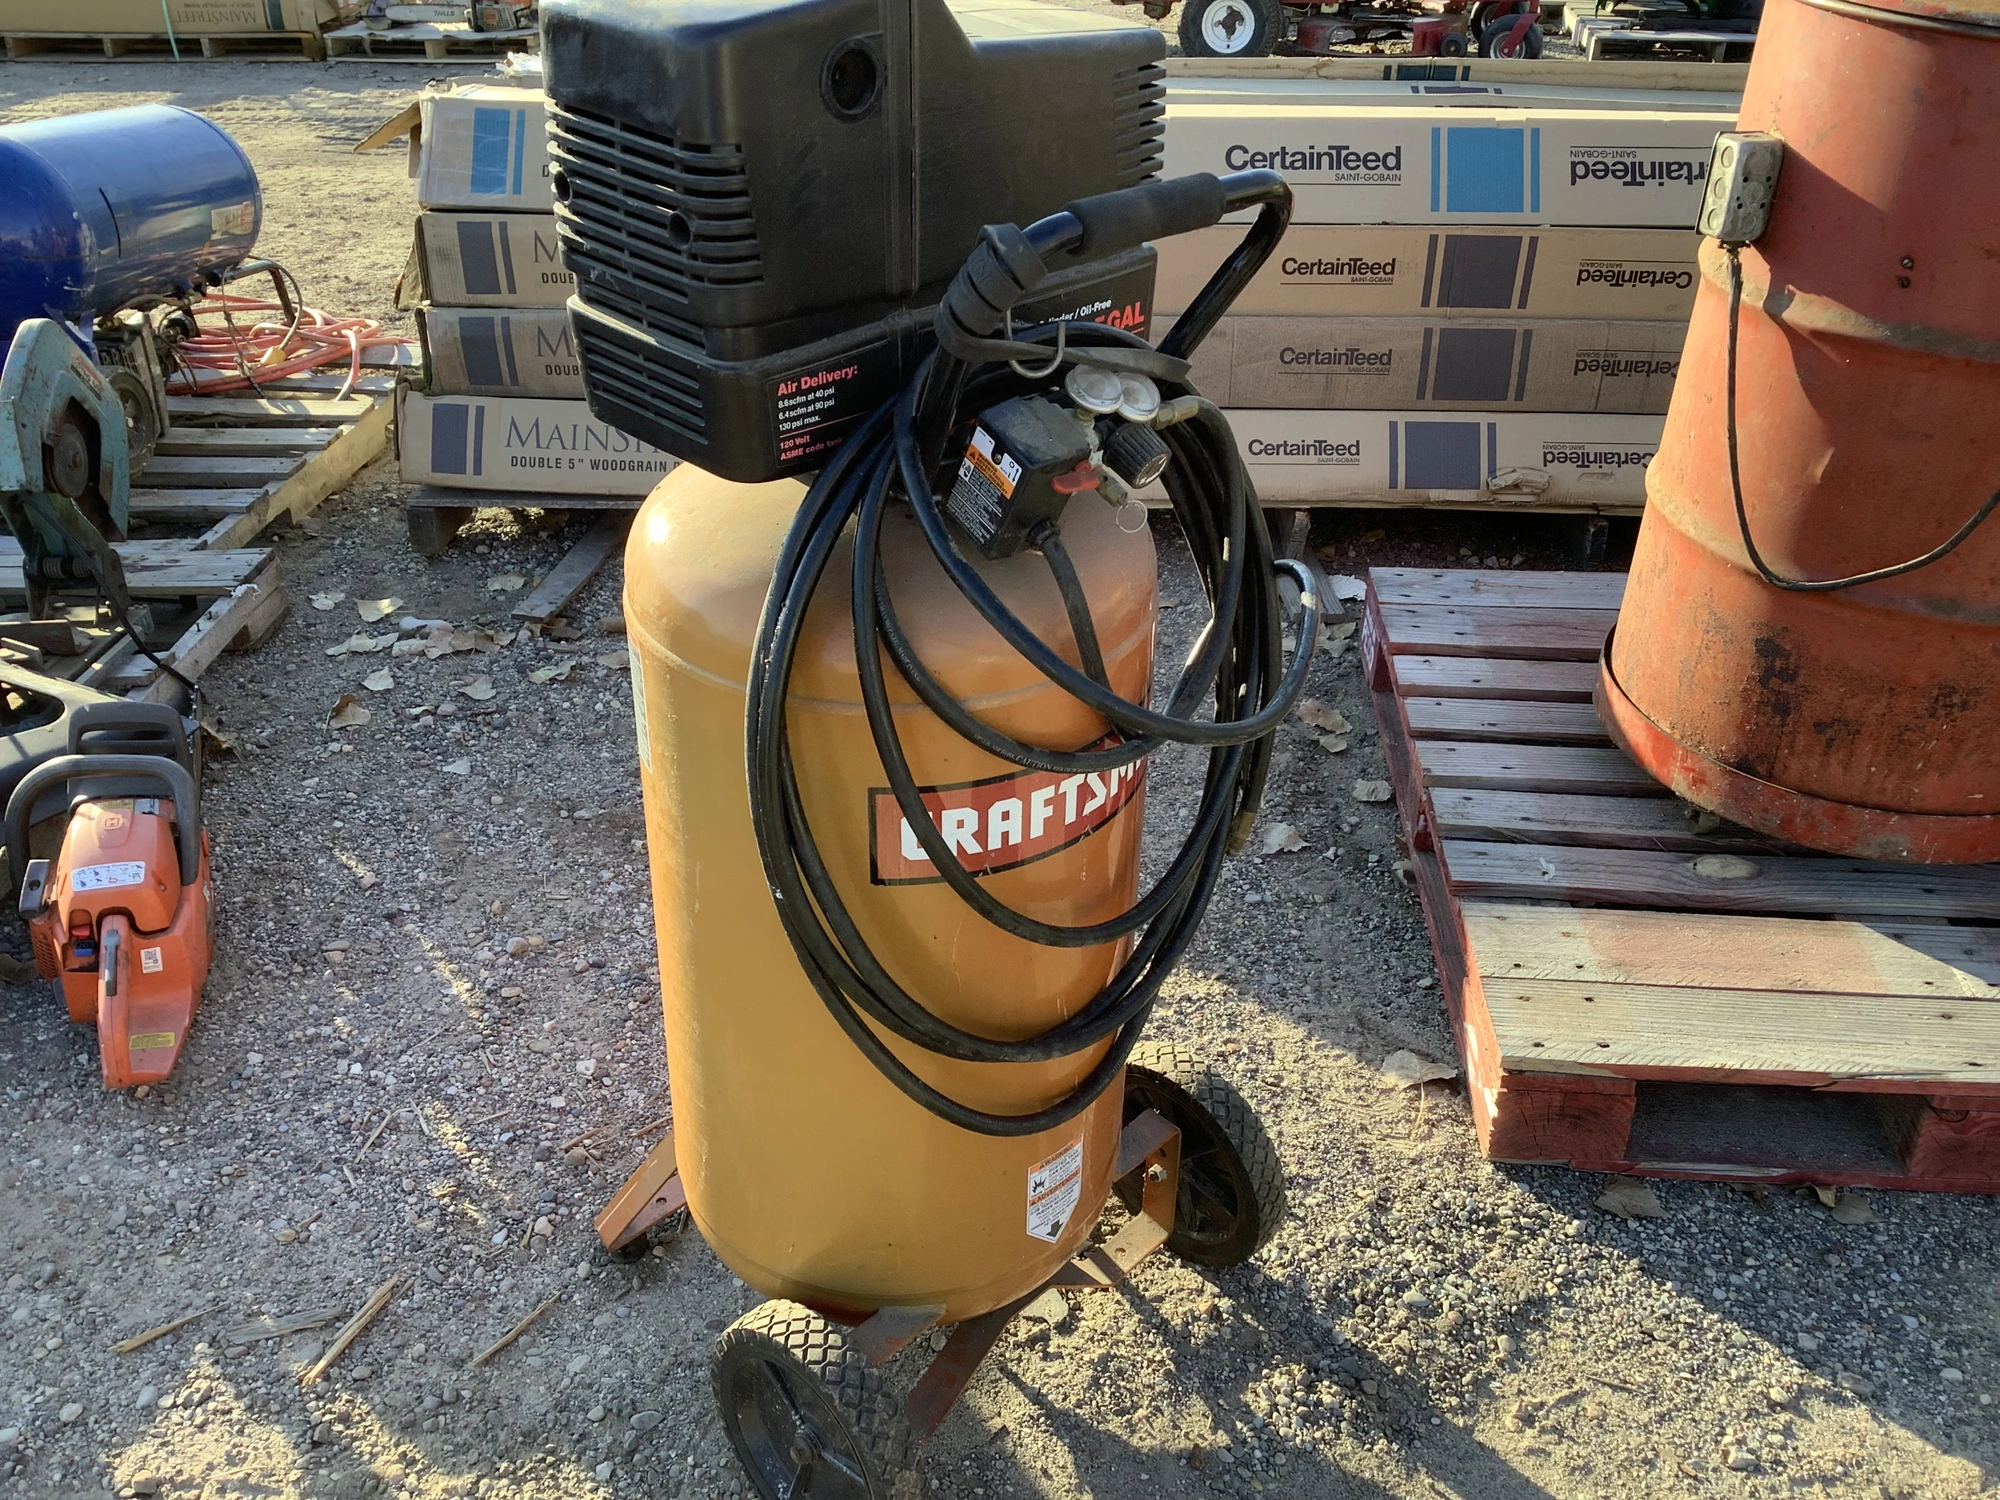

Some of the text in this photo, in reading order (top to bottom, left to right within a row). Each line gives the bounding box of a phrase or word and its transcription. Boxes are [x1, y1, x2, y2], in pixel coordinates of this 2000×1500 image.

[1225, 145, 1402, 171] CertainTeed
[1570, 150, 1637, 158] SAINT-GOBAIN
[1335, 173, 1402, 182] SAINT-GOBAIN
[1571, 161, 1709, 187] rtainTeed
[1281, 257, 1397, 275] CertainTeed
[1576, 269, 1693, 289] CertainTeed
[1080, 299, 1112, 316] Oil-Free
[1279, 347, 1392, 366] CertainTeed
[777, 365, 858, 396] Air Delivery:
[807, 392, 815, 400] at
[815, 389, 824, 399] 40
[824, 386, 835, 397] psi
[807, 404, 815, 412] at
[815, 400, 824, 410] 90
[824, 397, 835, 409] psi
[779, 415, 821, 431] 130 psi max.
[780, 435, 811, 449] 120 Volt
[1248, 439, 1360, 456] CertainTeed
[780, 447, 804, 460] ASME
[805, 442, 825, 454] code
[511, 455, 562, 469] DOUBLE
[568, 458, 585, 470] 5"
[590, 458, 667, 473] WOODGRAIN
